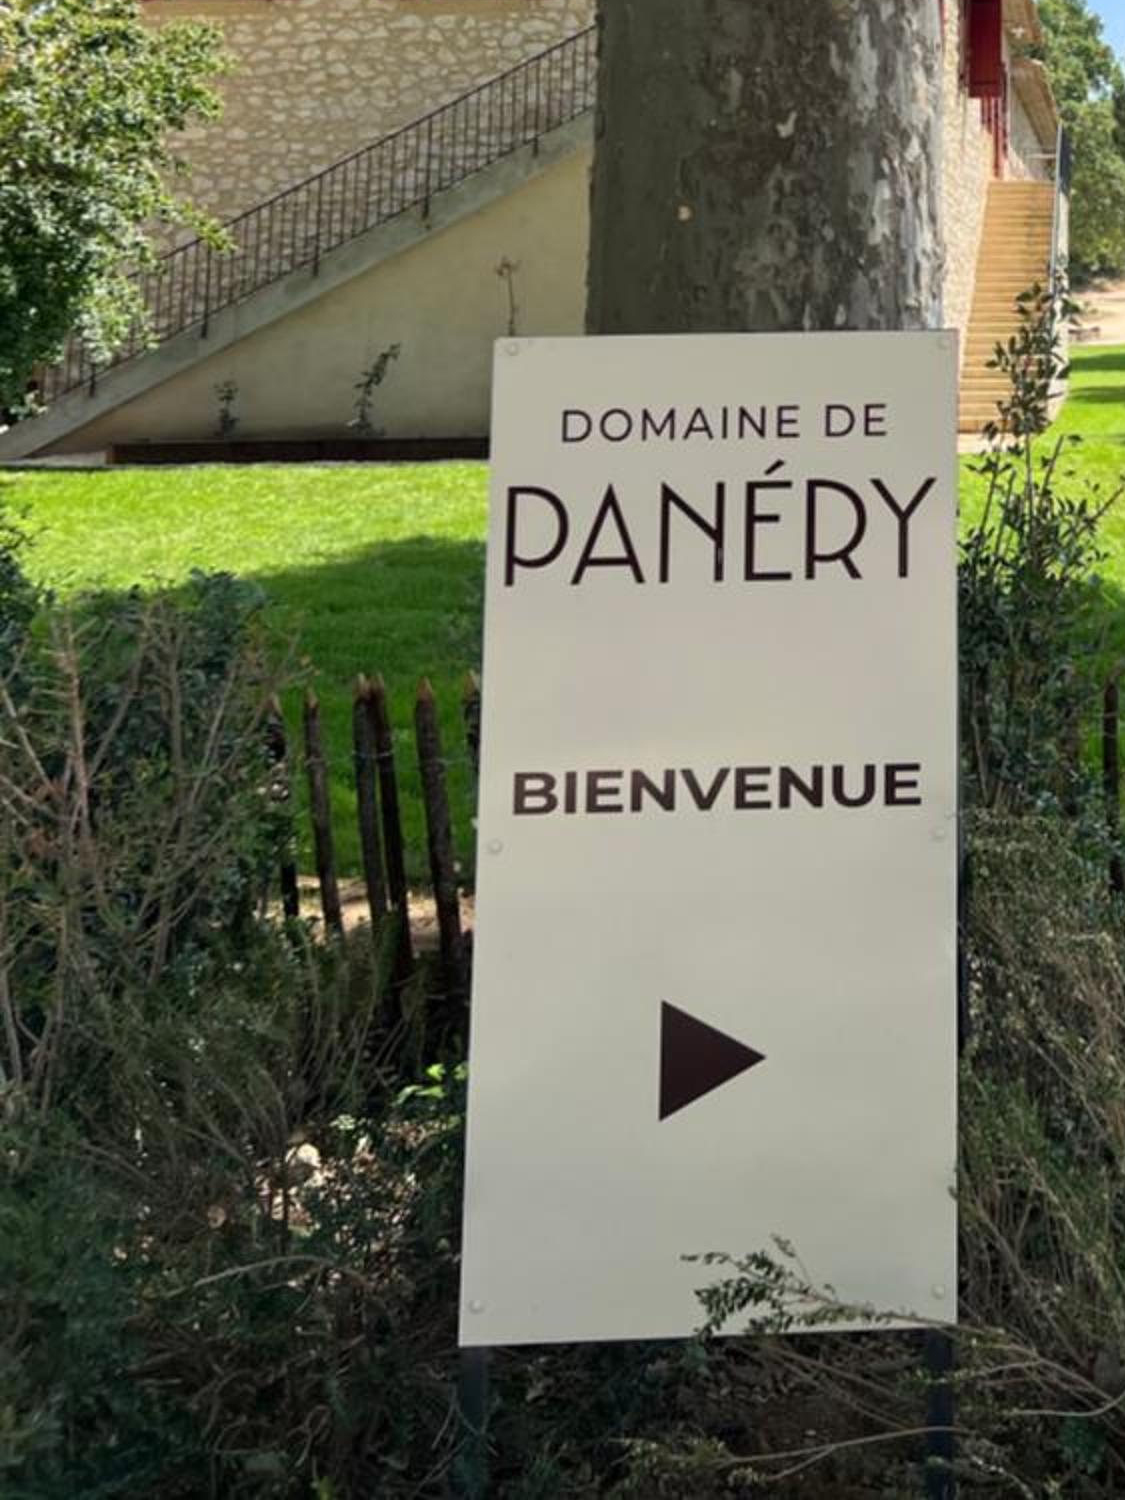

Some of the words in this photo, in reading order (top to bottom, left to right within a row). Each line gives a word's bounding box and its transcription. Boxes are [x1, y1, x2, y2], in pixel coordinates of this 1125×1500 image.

[561, 404, 801, 443] DOMAINE
[824, 403, 887, 438] DE
[504, 459, 937, 588] PANÉRY
[512, 762, 922, 817] BIENVENUE
